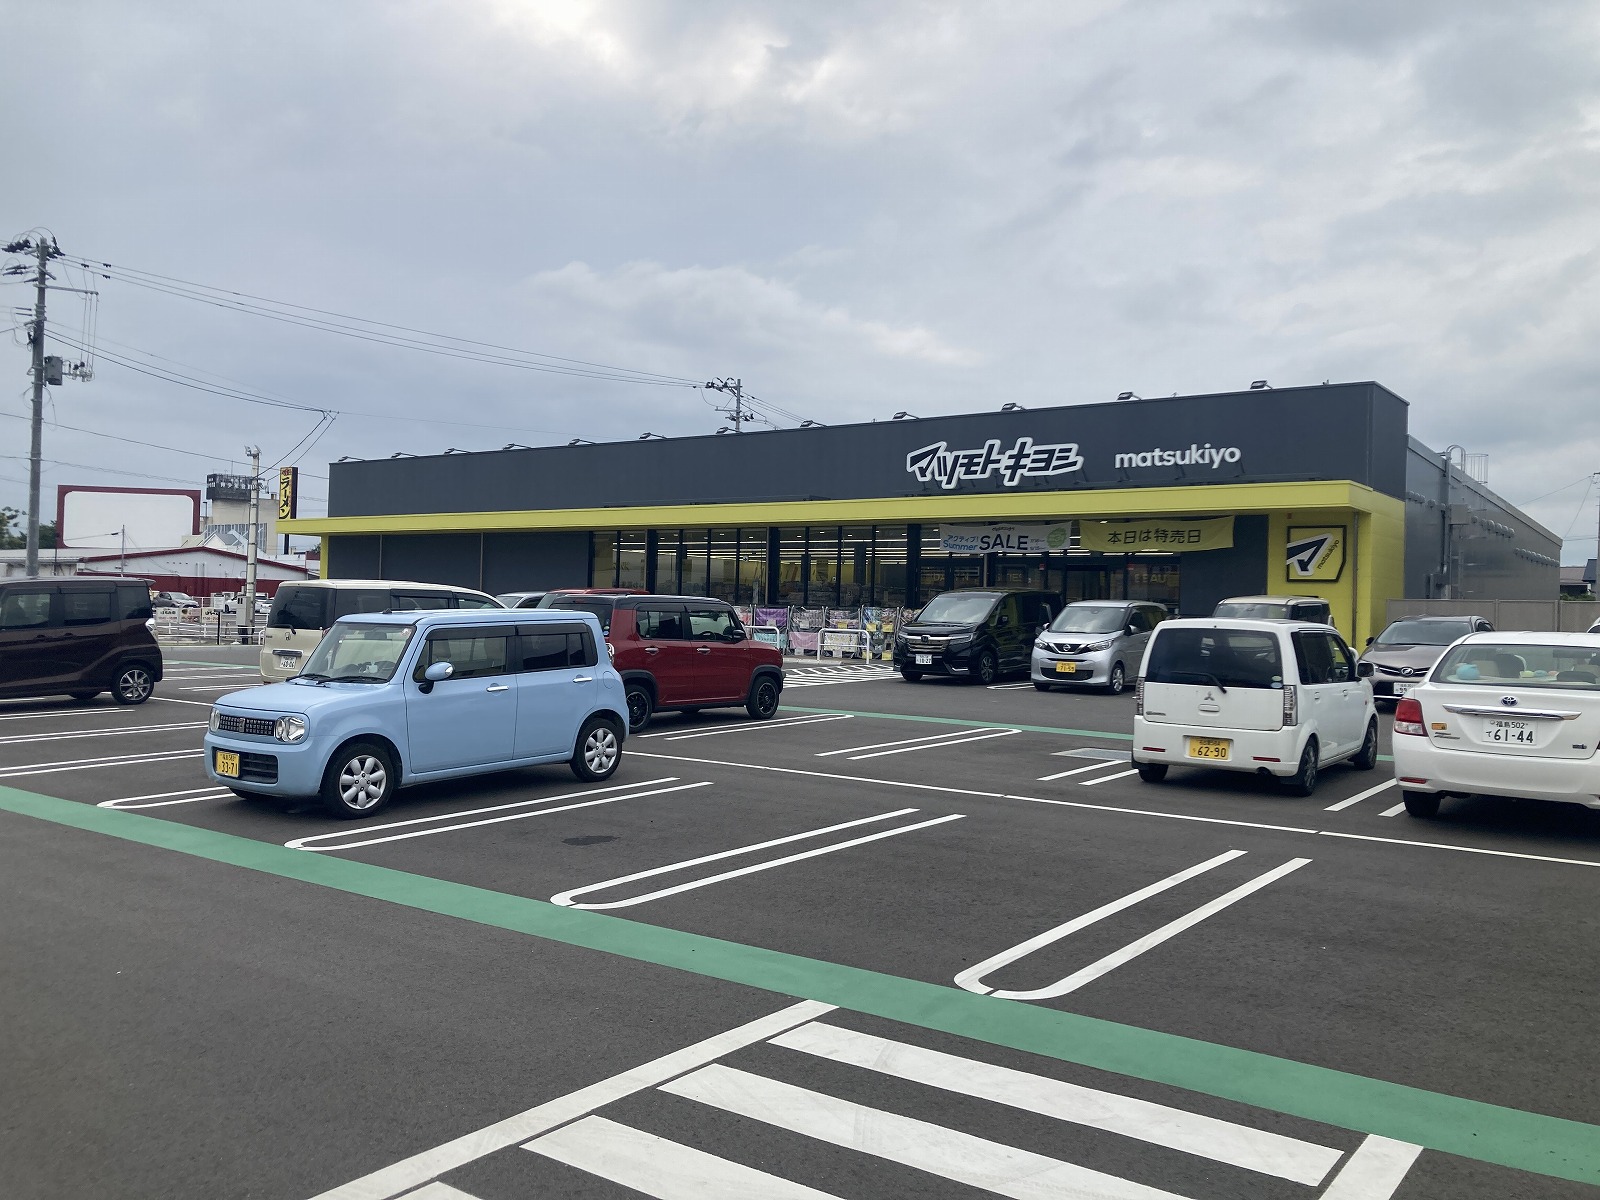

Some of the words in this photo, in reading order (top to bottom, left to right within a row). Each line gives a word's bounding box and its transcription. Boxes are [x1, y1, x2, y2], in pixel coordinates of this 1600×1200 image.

[906, 437, 1084, 489] マツモトキヨシ
[1114, 443, 1242, 469] matsukiyo
[279, 476, 291, 520] ラーメン
[942, 540, 979, 551] Summer
[979, 533, 1029, 551] SALE
[1107, 528, 1202, 544] 本日は特売日
[1316, 539, 1340, 570] matsukiyo
[1493, 729, 1534, 744] 61-44
[1197, 746, 1227, 758] 62-90
[221, 761, 238, 775] 33-71
